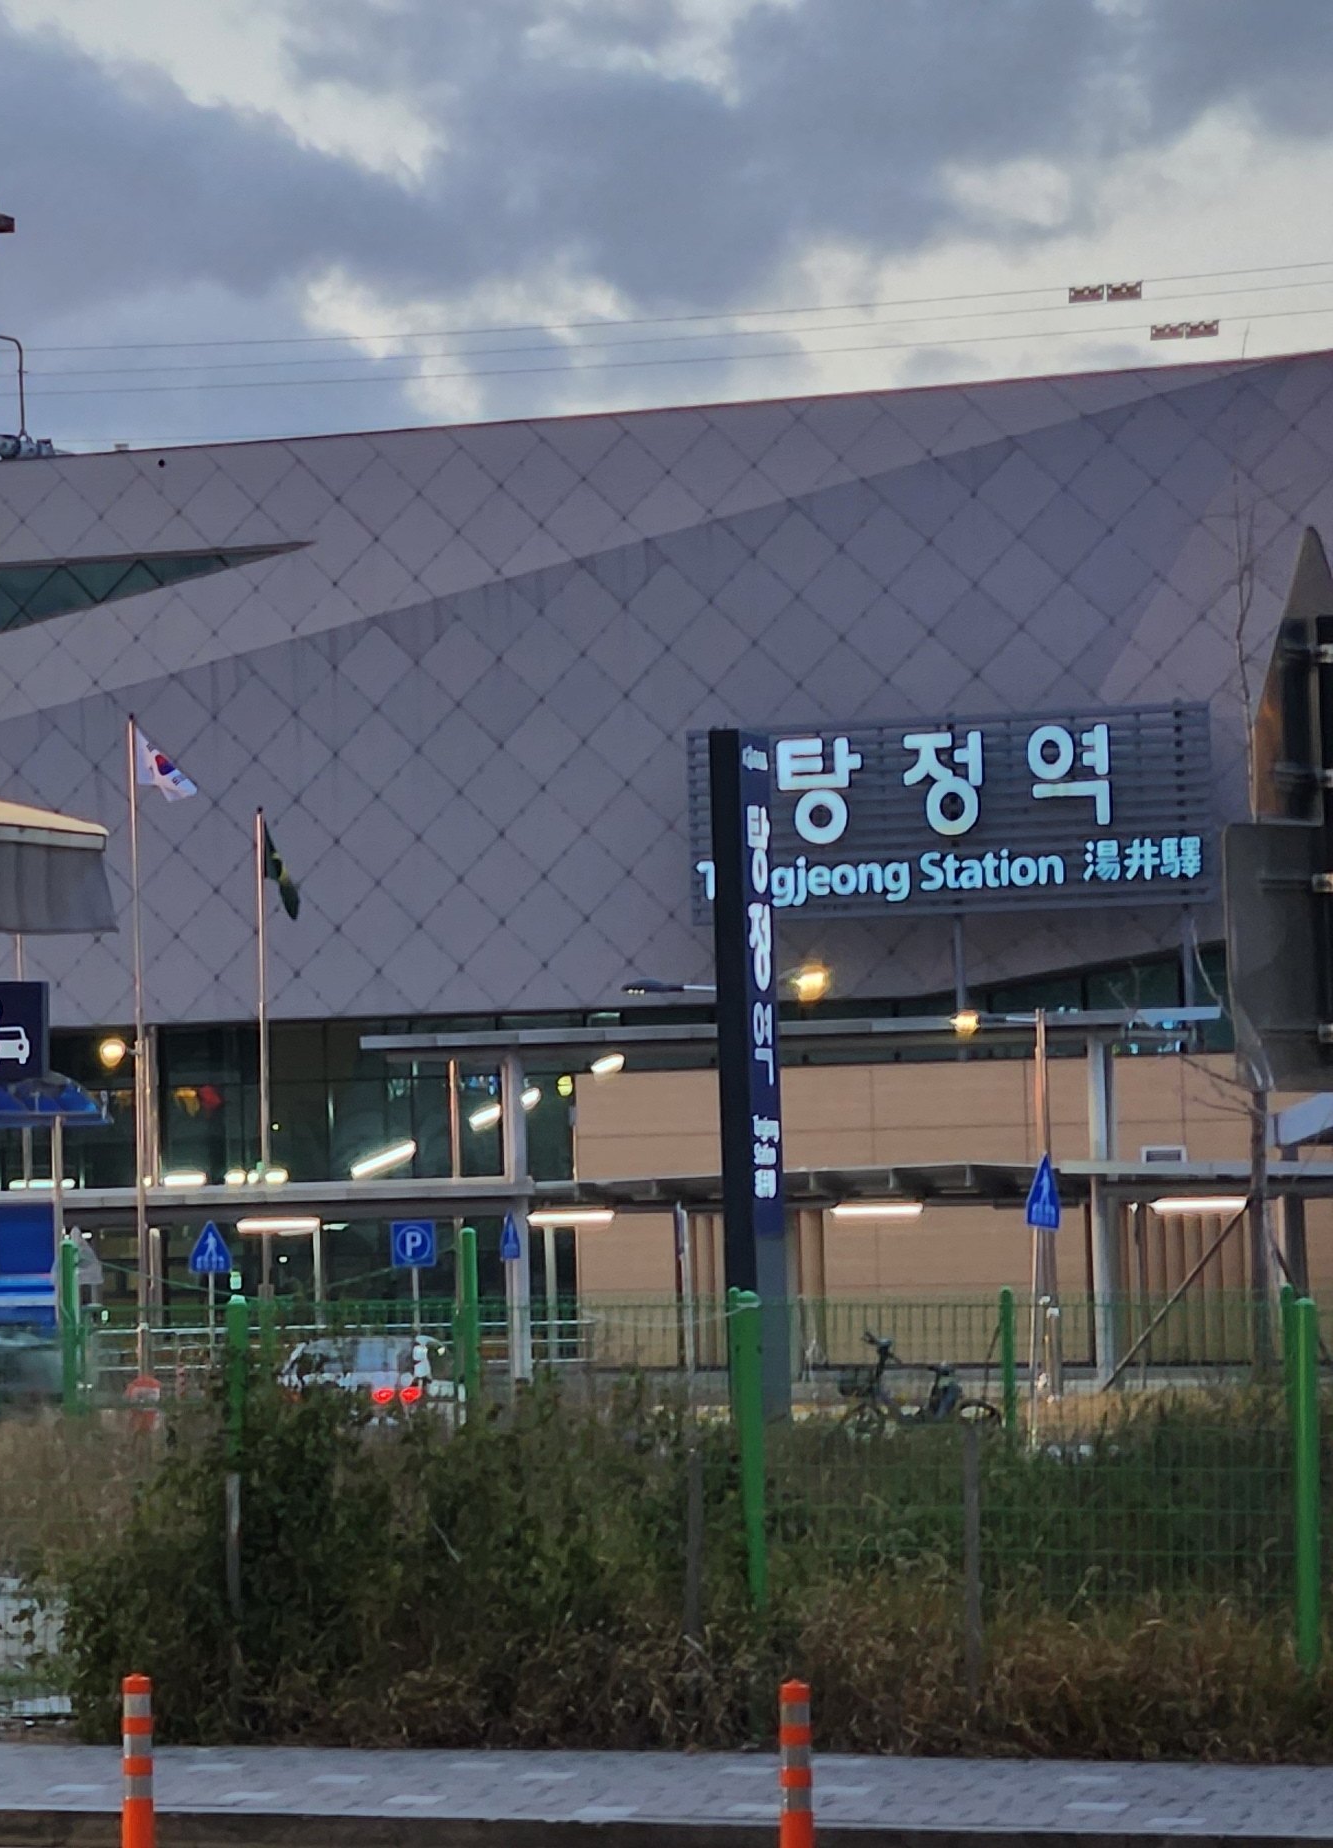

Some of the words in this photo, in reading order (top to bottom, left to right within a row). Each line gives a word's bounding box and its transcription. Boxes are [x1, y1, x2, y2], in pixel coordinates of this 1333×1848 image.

[775, 723, 1111, 845] 탕정역
[696, 855, 911, 907] Tgjeong
[920, 848, 1064, 892] Station
[405, 1231, 422, 1257] P
